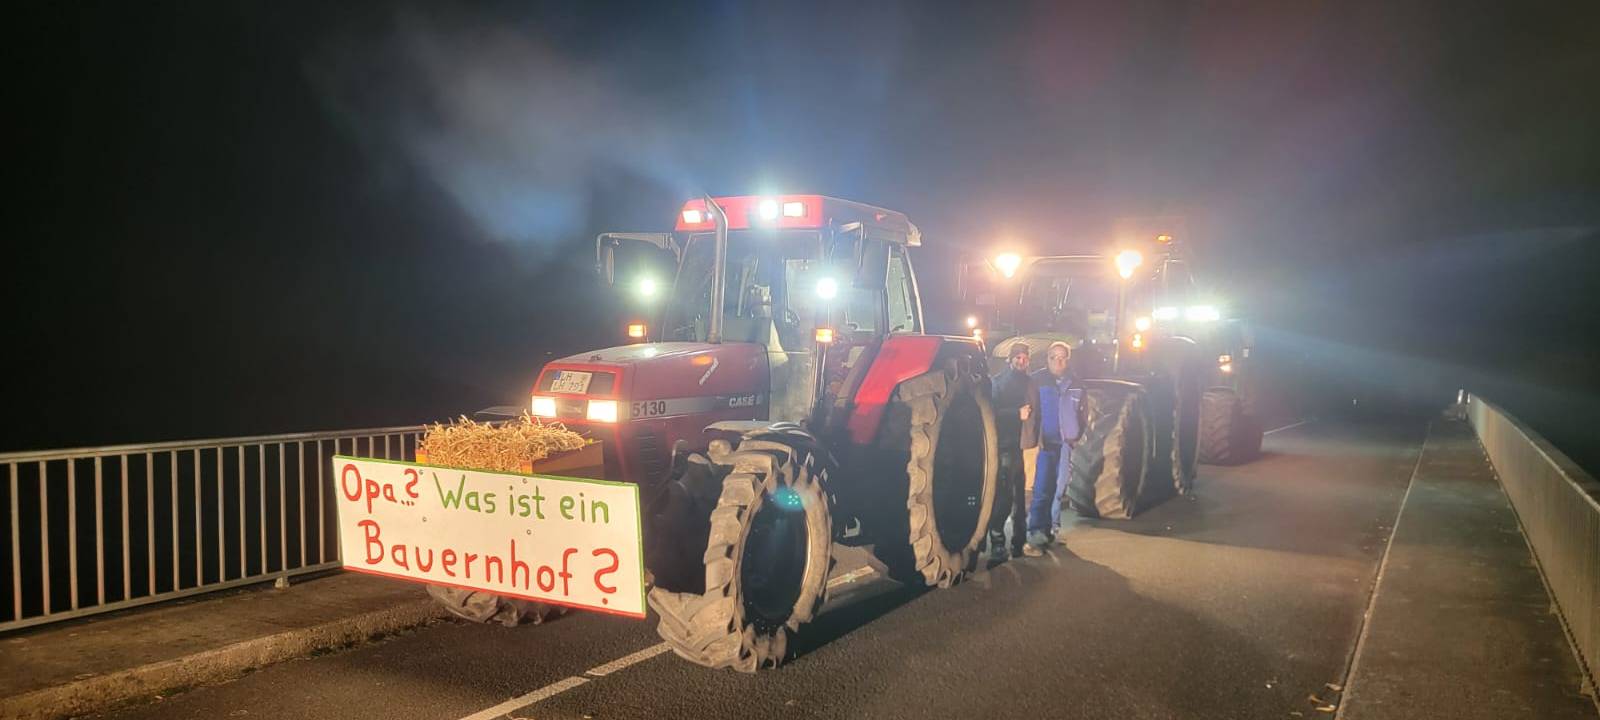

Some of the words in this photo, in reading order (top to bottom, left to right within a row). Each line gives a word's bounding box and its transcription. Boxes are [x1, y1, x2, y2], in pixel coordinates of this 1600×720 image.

[632, 400, 666, 417] 5130
[728, 394, 755, 408] CASE
[432, 471, 497, 514] Was
[509, 485, 546, 520] ist
[559, 492, 609, 524] ein
